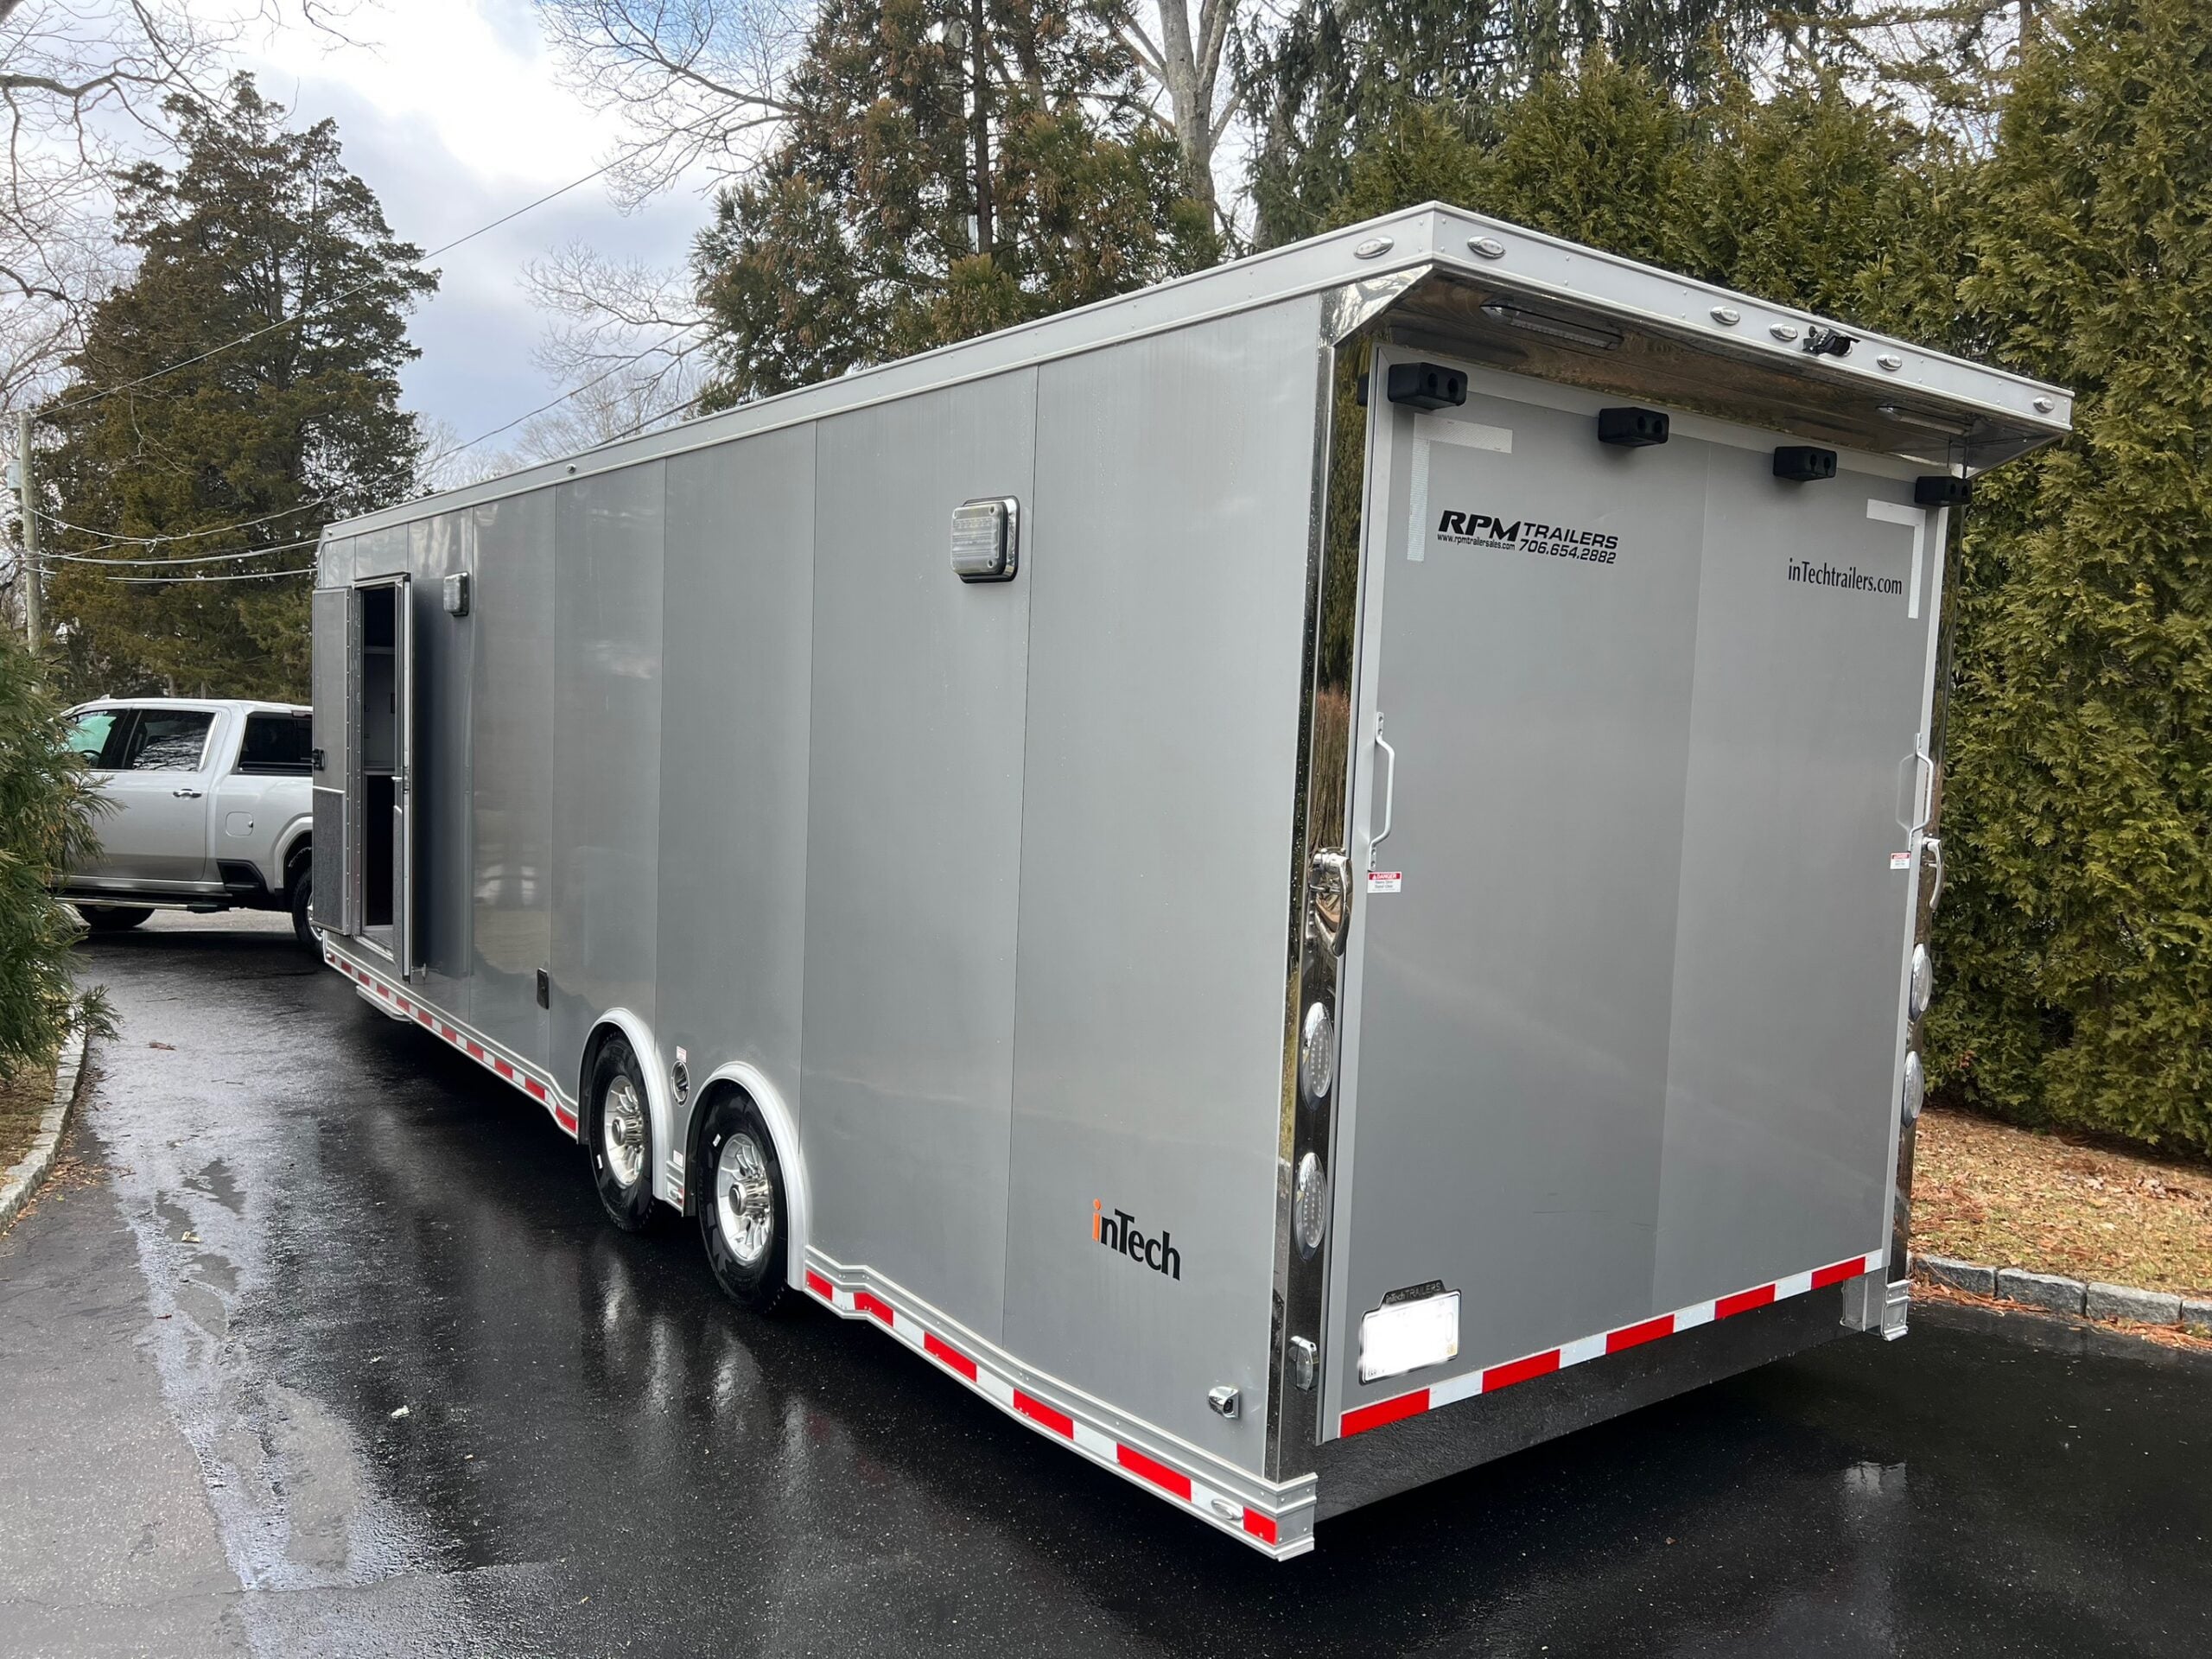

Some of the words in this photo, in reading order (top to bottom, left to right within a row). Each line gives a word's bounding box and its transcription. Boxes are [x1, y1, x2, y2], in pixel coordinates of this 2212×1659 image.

[1437, 533, 1516, 551] www.rpmtrailersales.com
[1438, 510, 1522, 543] RPM
[1523, 522, 1618, 550] TRAILERS
[1519, 538, 1617, 564] 706.654.2882
[1788, 557, 1903, 594] inTechtrailers.com
[1091, 1198, 1181, 1281] inTech
